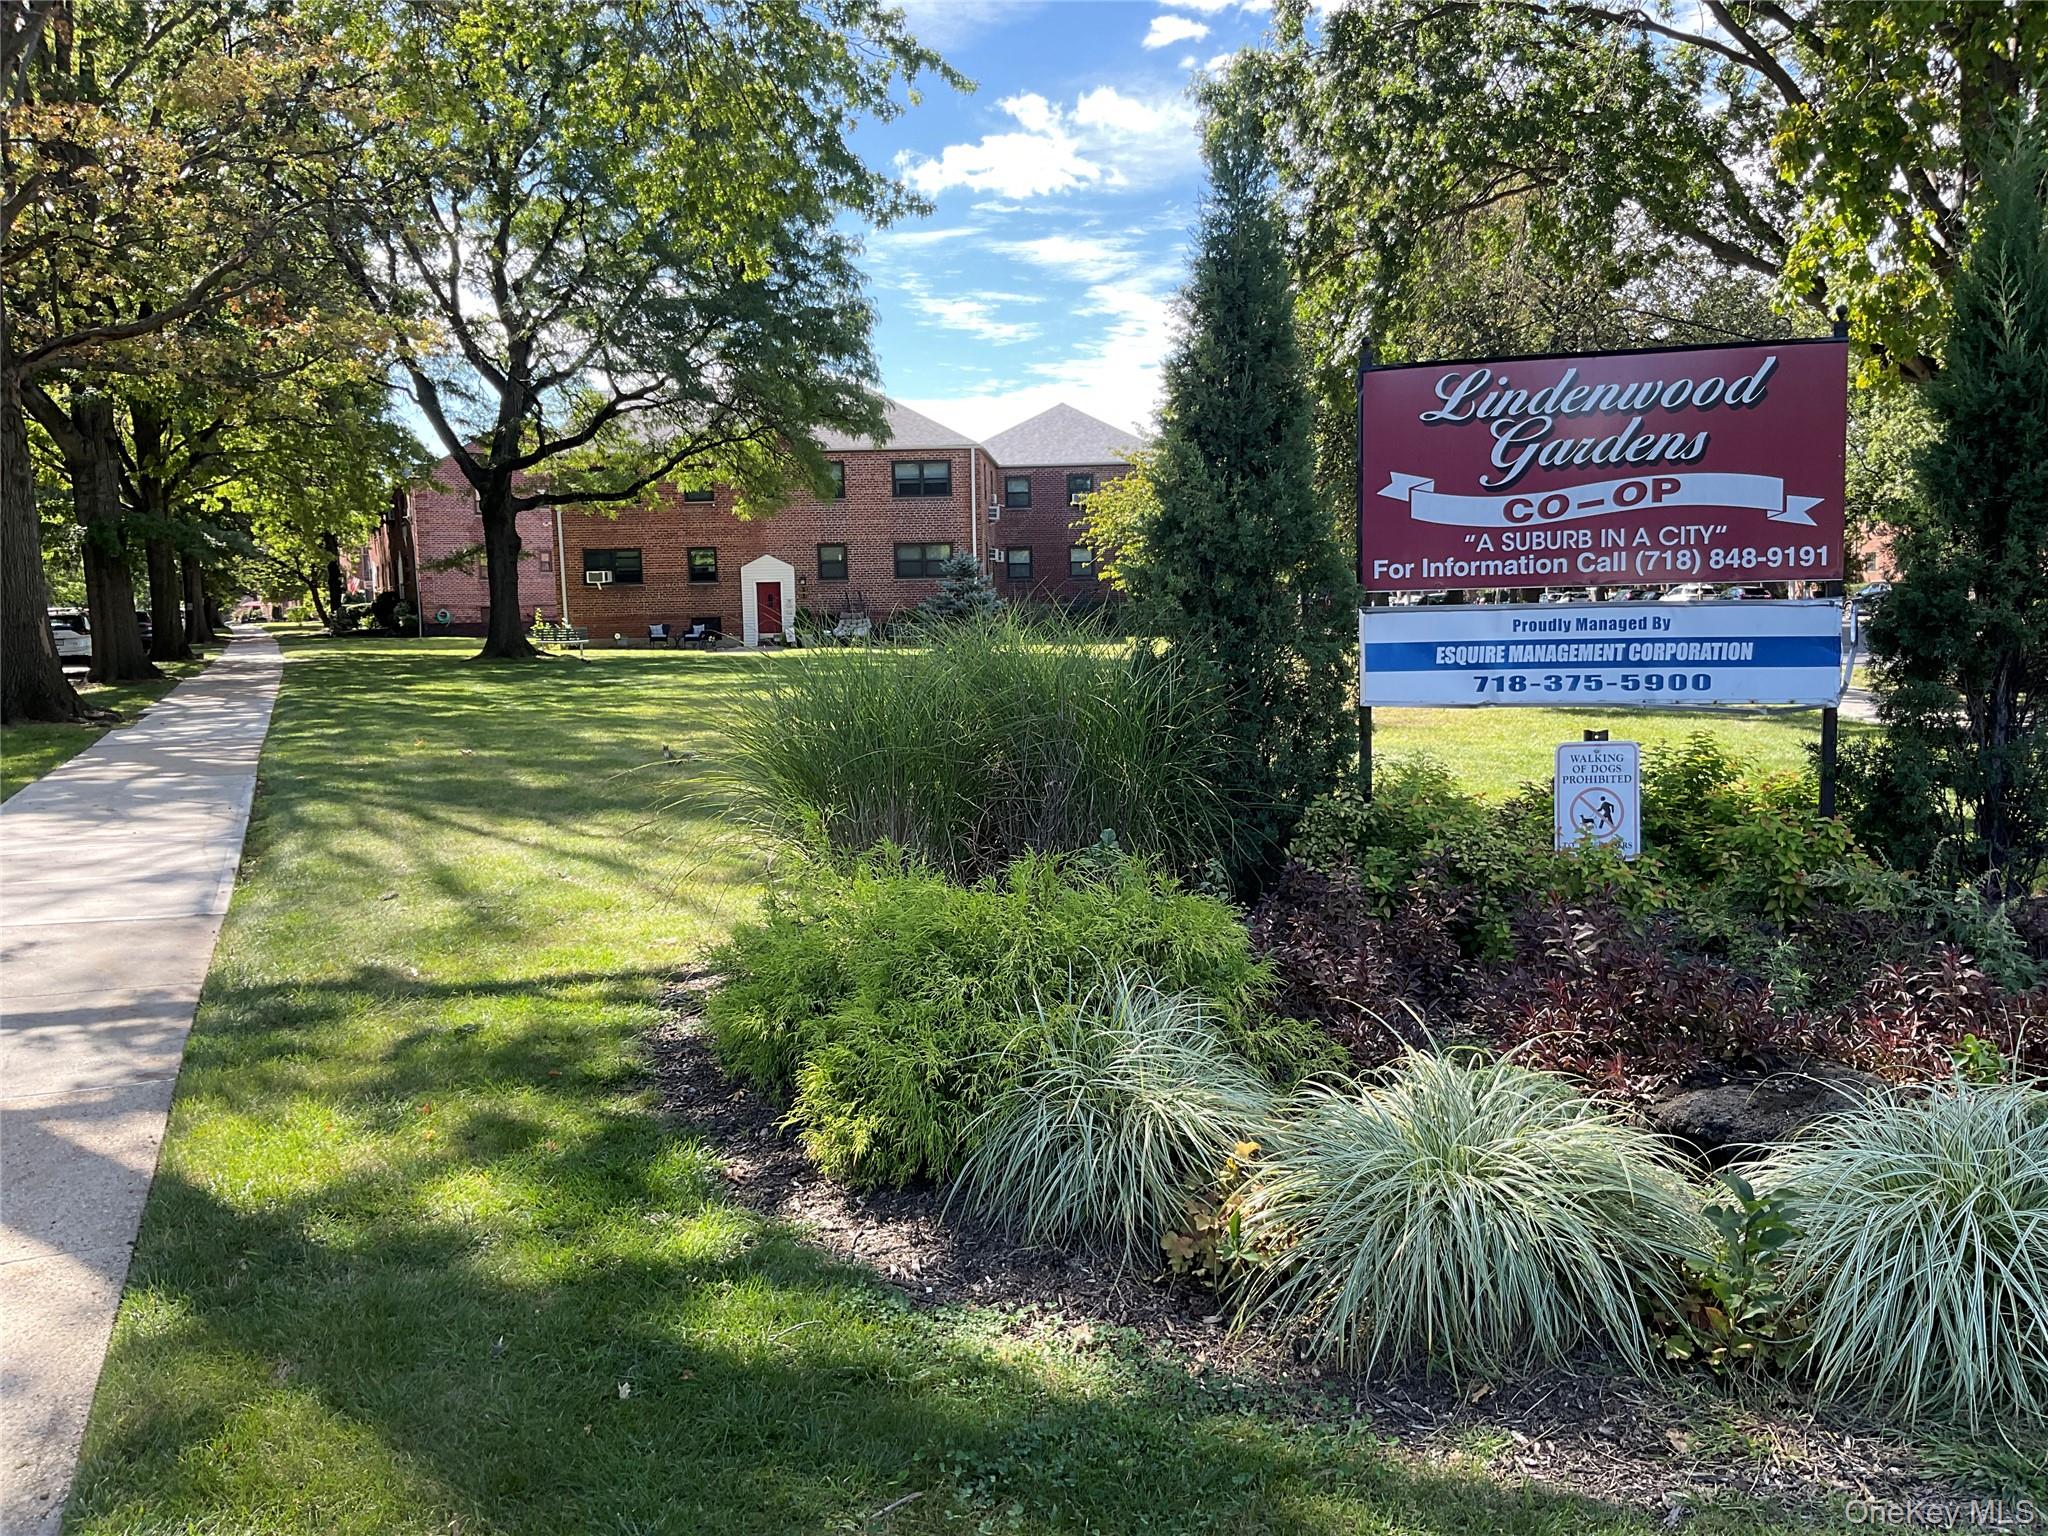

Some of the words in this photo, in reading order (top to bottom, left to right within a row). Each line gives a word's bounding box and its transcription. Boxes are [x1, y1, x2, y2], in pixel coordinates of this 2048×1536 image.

[1419, 356, 1777, 422] Lindenwood
[1480, 416, 1709, 488] Gardens
[1501, 529, 1592, 552] SUBURB
[1601, 527, 1625, 548] IN
[1632, 527, 1651, 547] A
[1373, 559, 1414, 580] For
[1422, 554, 1568, 578] Information
[1577, 551, 1626, 573] Call
[1635, 549, 1700, 576] (718)
[1709, 545, 1828, 570] 848-9191
[1512, 618, 1571, 633] Proudly
[1576, 616, 1647, 632] Managed
[1652, 616, 1671, 631] By
[1436, 645, 1505, 665] ESQUIRE
[1508, 643, 1626, 663] MANAGEMENT
[1628, 642, 1754, 661] CORPORATION
[1473, 673, 1711, 692] 718-375-5900
[1570, 754, 1624, 763] WALKING
[1572, 765, 1589, 773] OF
[1591, 765, 1622, 773] DOGS
[1562, 775, 1632, 784] PROHIBITED
